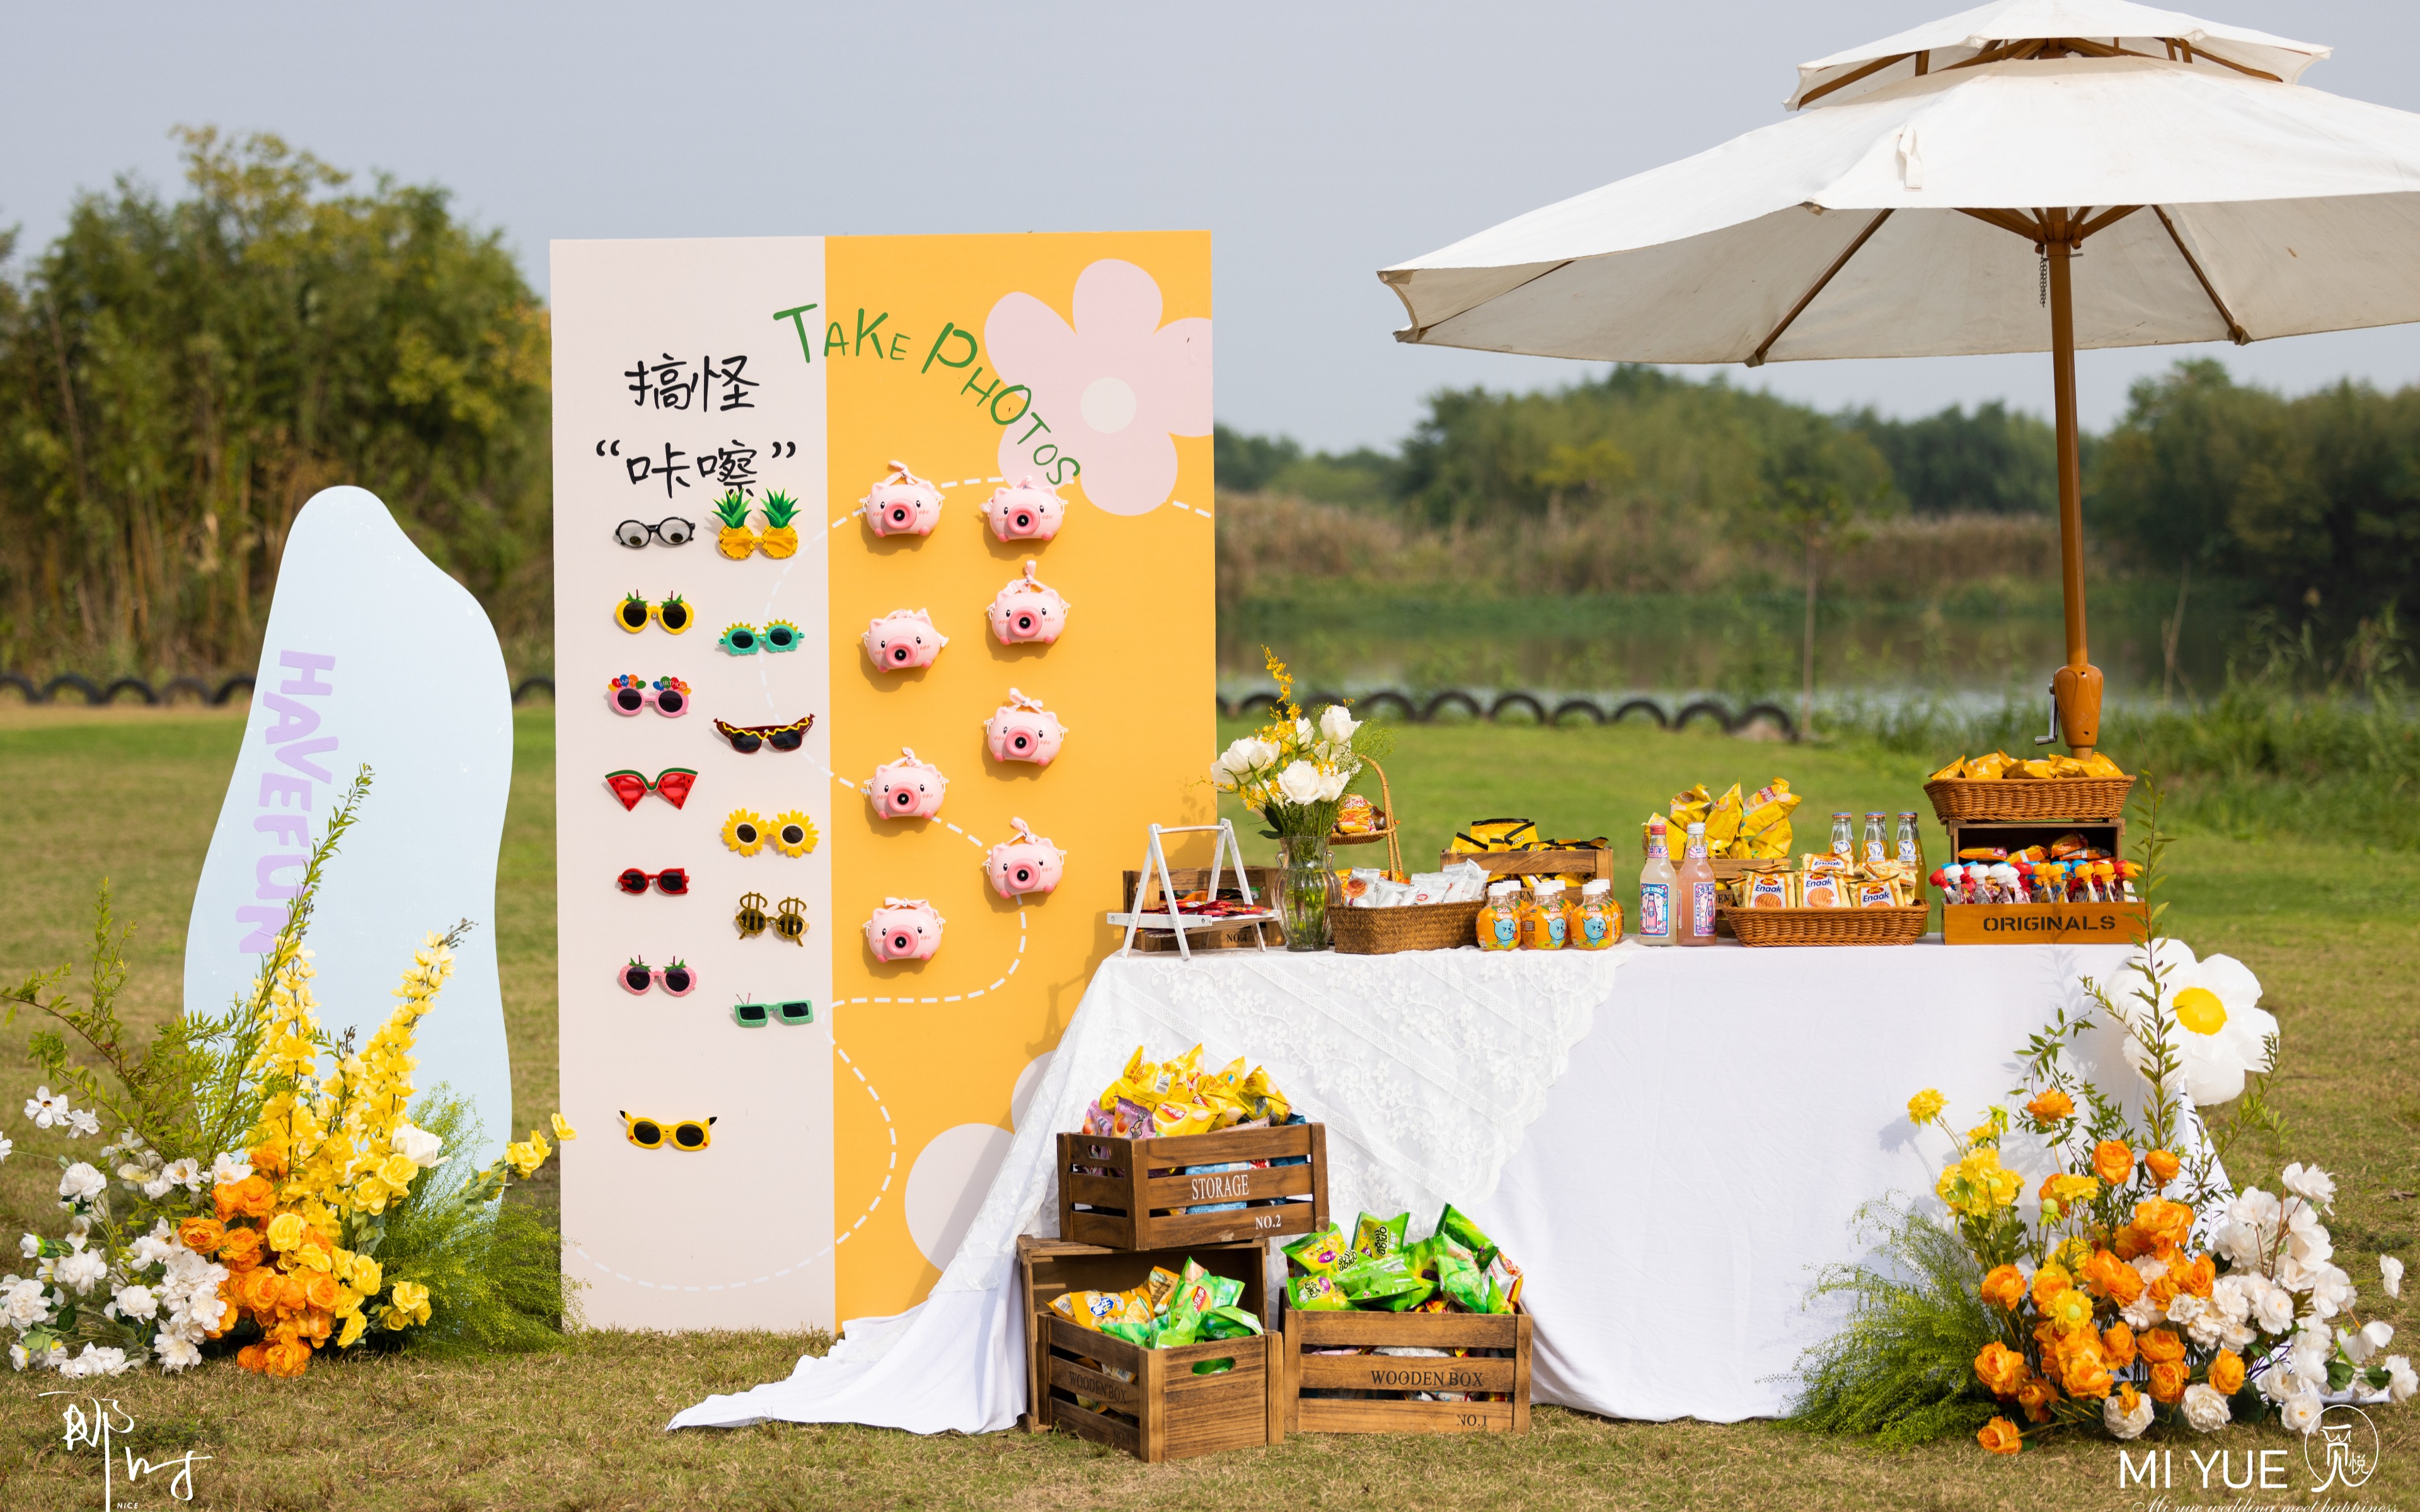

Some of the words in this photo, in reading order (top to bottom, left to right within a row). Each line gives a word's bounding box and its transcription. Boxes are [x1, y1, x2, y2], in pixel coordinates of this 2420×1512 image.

[624, 353, 760, 413] 搞怪
[773, 303, 911, 364] TAKE
[921, 322, 1081, 486] PHOTOS
[1755, 884, 1782, 893] Enaak
[1806, 878, 1833, 887] Enaak
[1863, 891, 1889, 902] Enaak
[1983, 915, 2116, 932] ORIGINALS
[1226, 933, 1248, 943] NO.4
[1192, 1174, 1250, 1201] STORAGE
[1255, 1215, 1282, 1230] NO.2
[1371, 1370, 1444, 1386] WOODEN
[1449, 1372, 1484, 1387] BOX
[1069, 1371, 1107, 1398] WOODEN
[1109, 1385, 1127, 1404] BOX
[1456, 1414, 1488, 1427] NO.1
